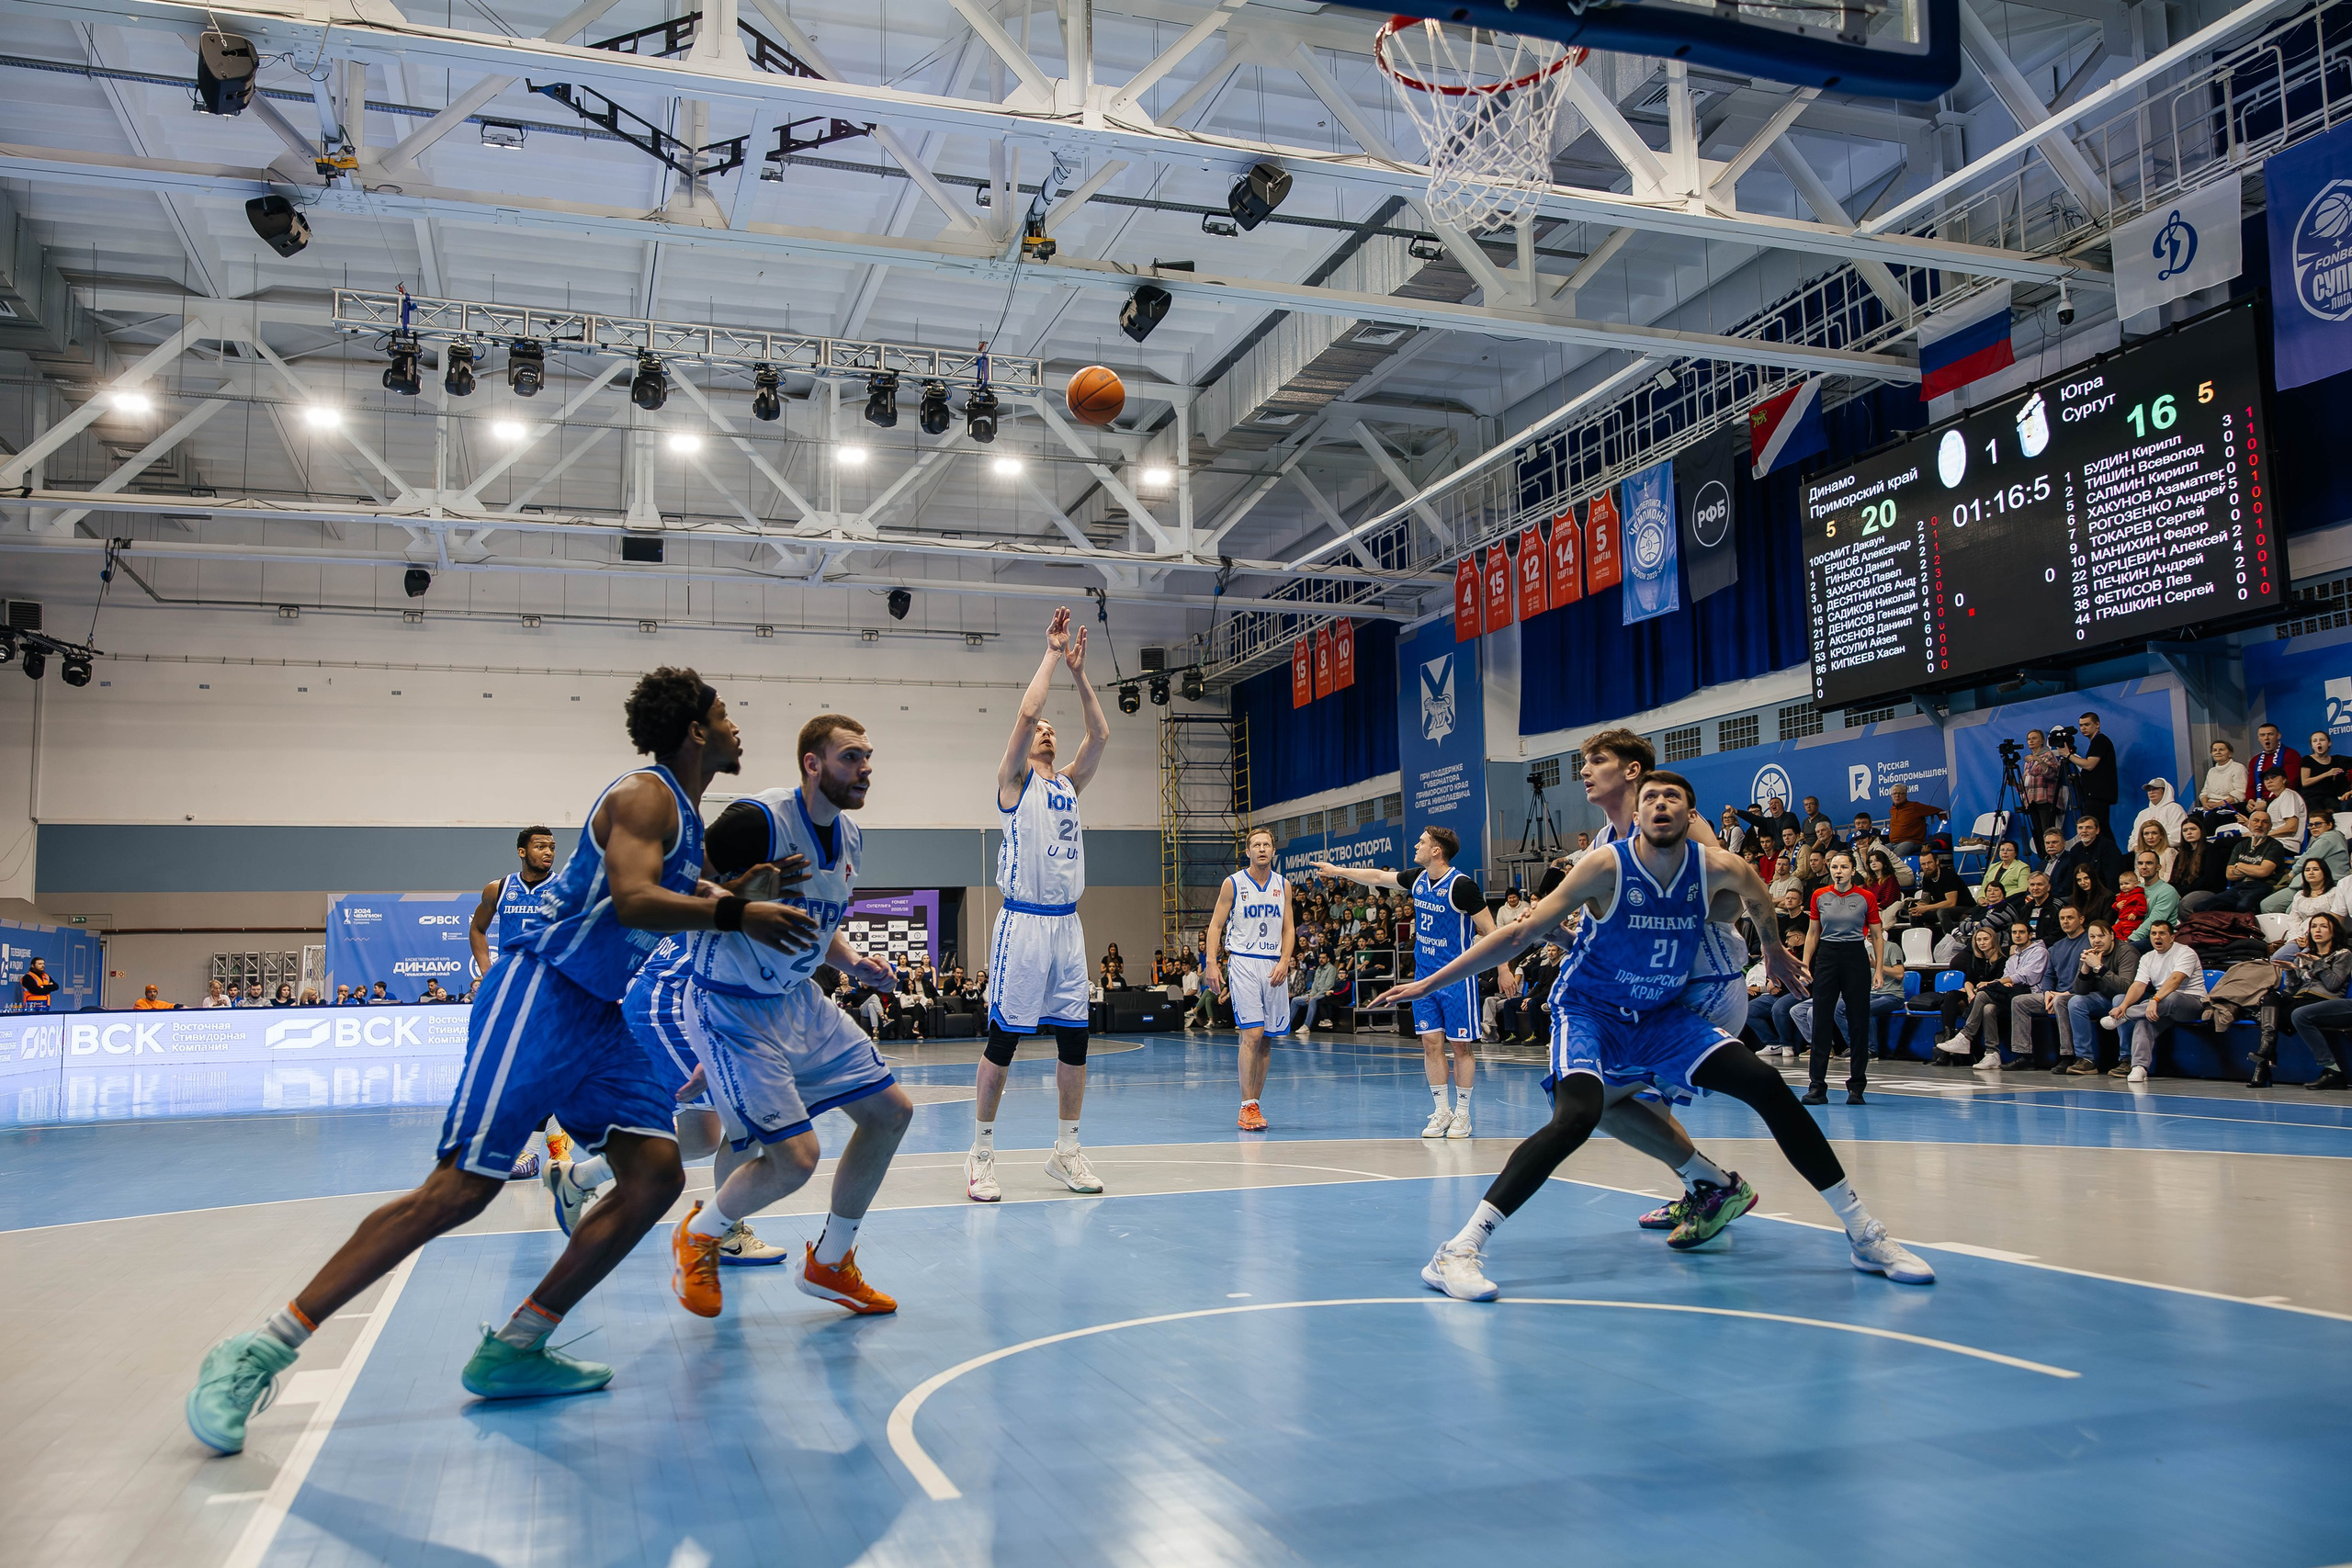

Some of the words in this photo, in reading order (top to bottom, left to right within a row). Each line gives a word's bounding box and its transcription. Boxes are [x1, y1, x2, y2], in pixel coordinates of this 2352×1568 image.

[2331, 291, 2352, 310] ЛИГА
[2061, 376, 2104, 401] Югра
[2198, 380, 2214, 404] 5
[2062, 392, 2116, 423] Сургут
[2126, 394, 2177, 438] 16
[1985, 438, 1997, 464] 1
[2064, 471, 2071, 482] 1
[2084, 451, 2129, 476] БУДИН
[2132, 435, 2182, 459] Кирилл
[2065, 487, 2073, 498] 2
[2085, 465, 2135, 490] ТИШИН
[2139, 443, 2205, 473] Всеволод
[1809, 476, 1855, 502] Динамо
[1810, 480, 1884, 519] Приморский
[1887, 468, 1918, 491] край
[2066, 502, 2075, 512] 5
[2086, 476, 2144, 504] САЛМИН
[2148, 461, 2199, 485] Кирилл
[1698, 499, 1725, 529] РФБ
[1952, 475, 2051, 527] 01:16:5
[2067, 515, 2075, 526] 6
[2087, 491, 2152, 519] ХАКУНОВ
[2068, 529, 2076, 539] 7
[2088, 499, 2171, 533] РОГОЗЕНКО
[2176, 480, 2226, 507] Андрей
[1629, 509, 1668, 536] ЧЕМПИОНЫ
[1826, 520, 1837, 538] 5
[1861, 499, 1897, 536] 20
[2070, 544, 2077, 554] 9
[2090, 521, 2153, 547] ТОКАРЕВ
[2155, 505, 2205, 529] Сергей
[1597, 525, 1607, 551] 5
[1852, 536, 1885, 554] Дакаун
[2071, 556, 2086, 568] 10
[2091, 534, 2161, 562] МАНИХИН
[2164, 522, 2209, 541] Федор
[1556, 539, 1574, 569] 14
[1810, 570, 1815, 579] 1
[1825, 556, 1859, 574] ЕРШОВ
[1861, 540, 1911, 564] Александр
[2072, 570, 2087, 582] 22
[2092, 547, 2166, 577] КУРЦЕВИЧ
[2170, 531, 2229, 556] Алексей
[1523, 555, 1540, 582] 12
[1811, 582, 1815, 592] 2
[1826, 568, 1862, 586] ГИНЬКО
[1865, 558, 1894, 575] Данил
[2045, 568, 2055, 582] 0
[2073, 585, 2088, 597] 23
[2093, 567, 2149, 592] ПЕЧКИН
[2153, 553, 2204, 576] Андрей
[1464, 583, 1472, 606] 4
[1490, 570, 1504, 597] 15
[1811, 593, 1817, 604] 3
[1826, 577, 1870, 598] ЗАХАРОВ
[1872, 569, 1902, 584] Павел
[2075, 599, 2089, 612] 38
[2094, 580, 2163, 605] ФЕТИСОВ
[2165, 574, 2192, 589] Лев
[1813, 604, 1822, 615] 10
[1826, 583, 1893, 612] ДЕСЯТНИКОВ
[1813, 615, 1823, 626] 16
[1827, 602, 1872, 623] САДИКОВ
[1875, 589, 1916, 608] Николай
[1955, 593, 1964, 607] 0
[2075, 614, 2090, 626] 44
[2096, 595, 2162, 621] ГРАШКИН
[2165, 582, 2214, 604] Сергей
[1814, 629, 1824, 639] 21
[1828, 613, 1875, 637] ДЕНИСОВ
[1814, 640, 1825, 651] 27
[1829, 626, 1875, 647] АКСЕНОВ
[1876, 617, 1912, 635] Даниил
[2076, 629, 2085, 640] 0
[1320, 649, 1327, 670] 8
[1339, 638, 1350, 660] 10
[1815, 652, 1826, 662] 53
[1830, 640, 1867, 659] КРОУЛИ
[1870, 634, 1897, 649] Айзея
[1815, 664, 1826, 674] 86
[1831, 652, 1874, 671] КИПКЕЕВ
[1877, 645, 1905, 659] Хасан
[1296, 660, 1306, 680] 15
[1816, 678, 1822, 686] 0
[1817, 690, 1823, 698] 0
[2328, 725, 2352, 736] РЕГИО
[1420, 773, 1430, 782] ПРИ
[1430, 762, 1464, 778] ПОДДЕРЖКЕ
[1423, 773, 1460, 789] ГУБЕРНАТОРА
[1878, 761, 1909, 778] Русская
[1878, 768, 1948, 784] Рыбопромышлен
[1415, 799, 1431, 809] ОЛЕГА
[1431, 789, 1471, 805] НИКОЛАЕВИЧА
[1416, 784, 1453, 800] ПРИМОРСКОГО
[1454, 781, 1469, 791] КРАЯ
[1428, 802, 1457, 815] КОЖЕМЯКО
[1285, 844, 1352, 870] МИНИСТЕРСТВО
[1354, 837, 1392, 857] СПОРТА
[1244, 904, 1282, 919] ЮГРА
[1415, 898, 1445, 913] ДИНАМО
[437, 916, 460, 925] ВСК
[1259, 922, 1268, 938] 9
[1422, 946, 1435, 956] КРАЙ
[1650, 939, 1678, 968] 21
[393, 961, 462, 974] ДИНАМО
[1630, 985, 1664, 1000] КРАЙ
[173, 1022, 231, 1032] Восточная
[334, 1016, 423, 1049] ВСК
[428, 1016, 470, 1024] Восточн
[39, 1025, 64, 1058] ВСК
[70, 1022, 166, 1056] ВСК
[172, 1032, 246, 1043] Стивидорная
[172, 1043, 230, 1052] Компания
[763, 1111, 781, 1123] STK
